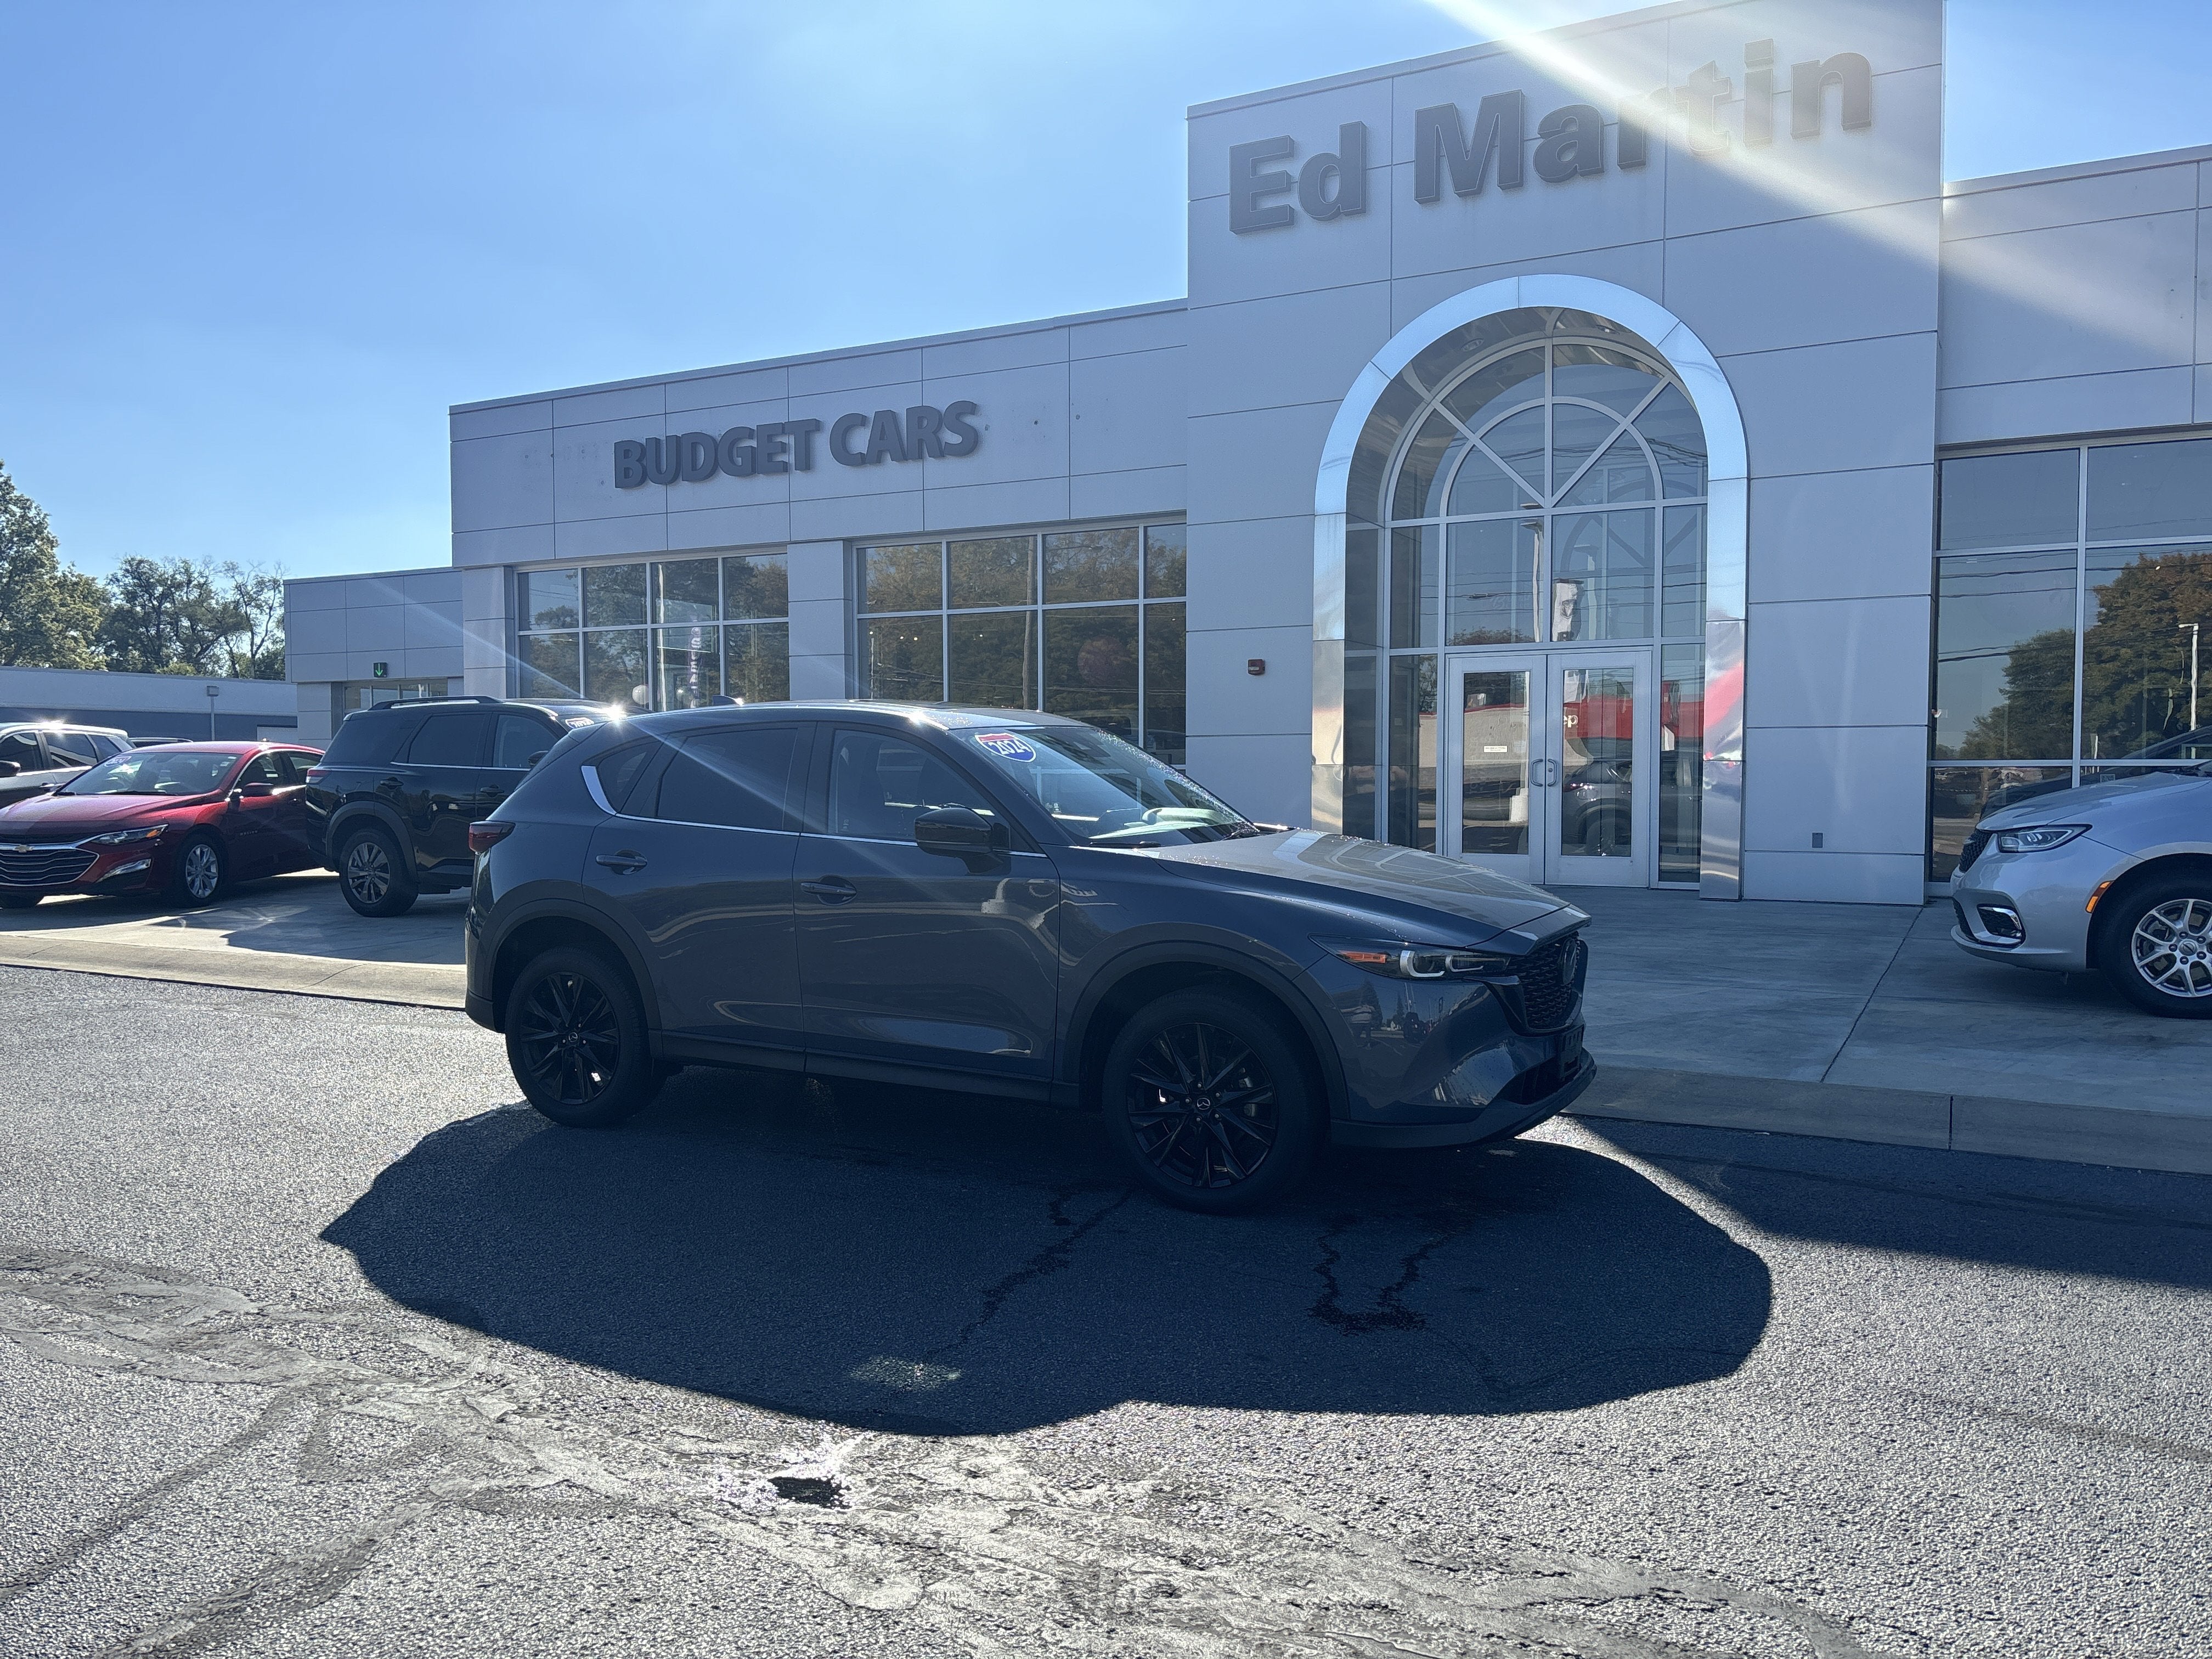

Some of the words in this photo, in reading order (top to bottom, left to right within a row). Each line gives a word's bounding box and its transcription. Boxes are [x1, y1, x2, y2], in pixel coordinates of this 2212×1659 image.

[1229, 121, 1367, 235] Ed
[1414, 38, 1872, 205] Martin
[613, 418, 821, 489] BUDGET
[829, 400, 979, 466] CARS
[988, 740, 1032, 754] 2024
